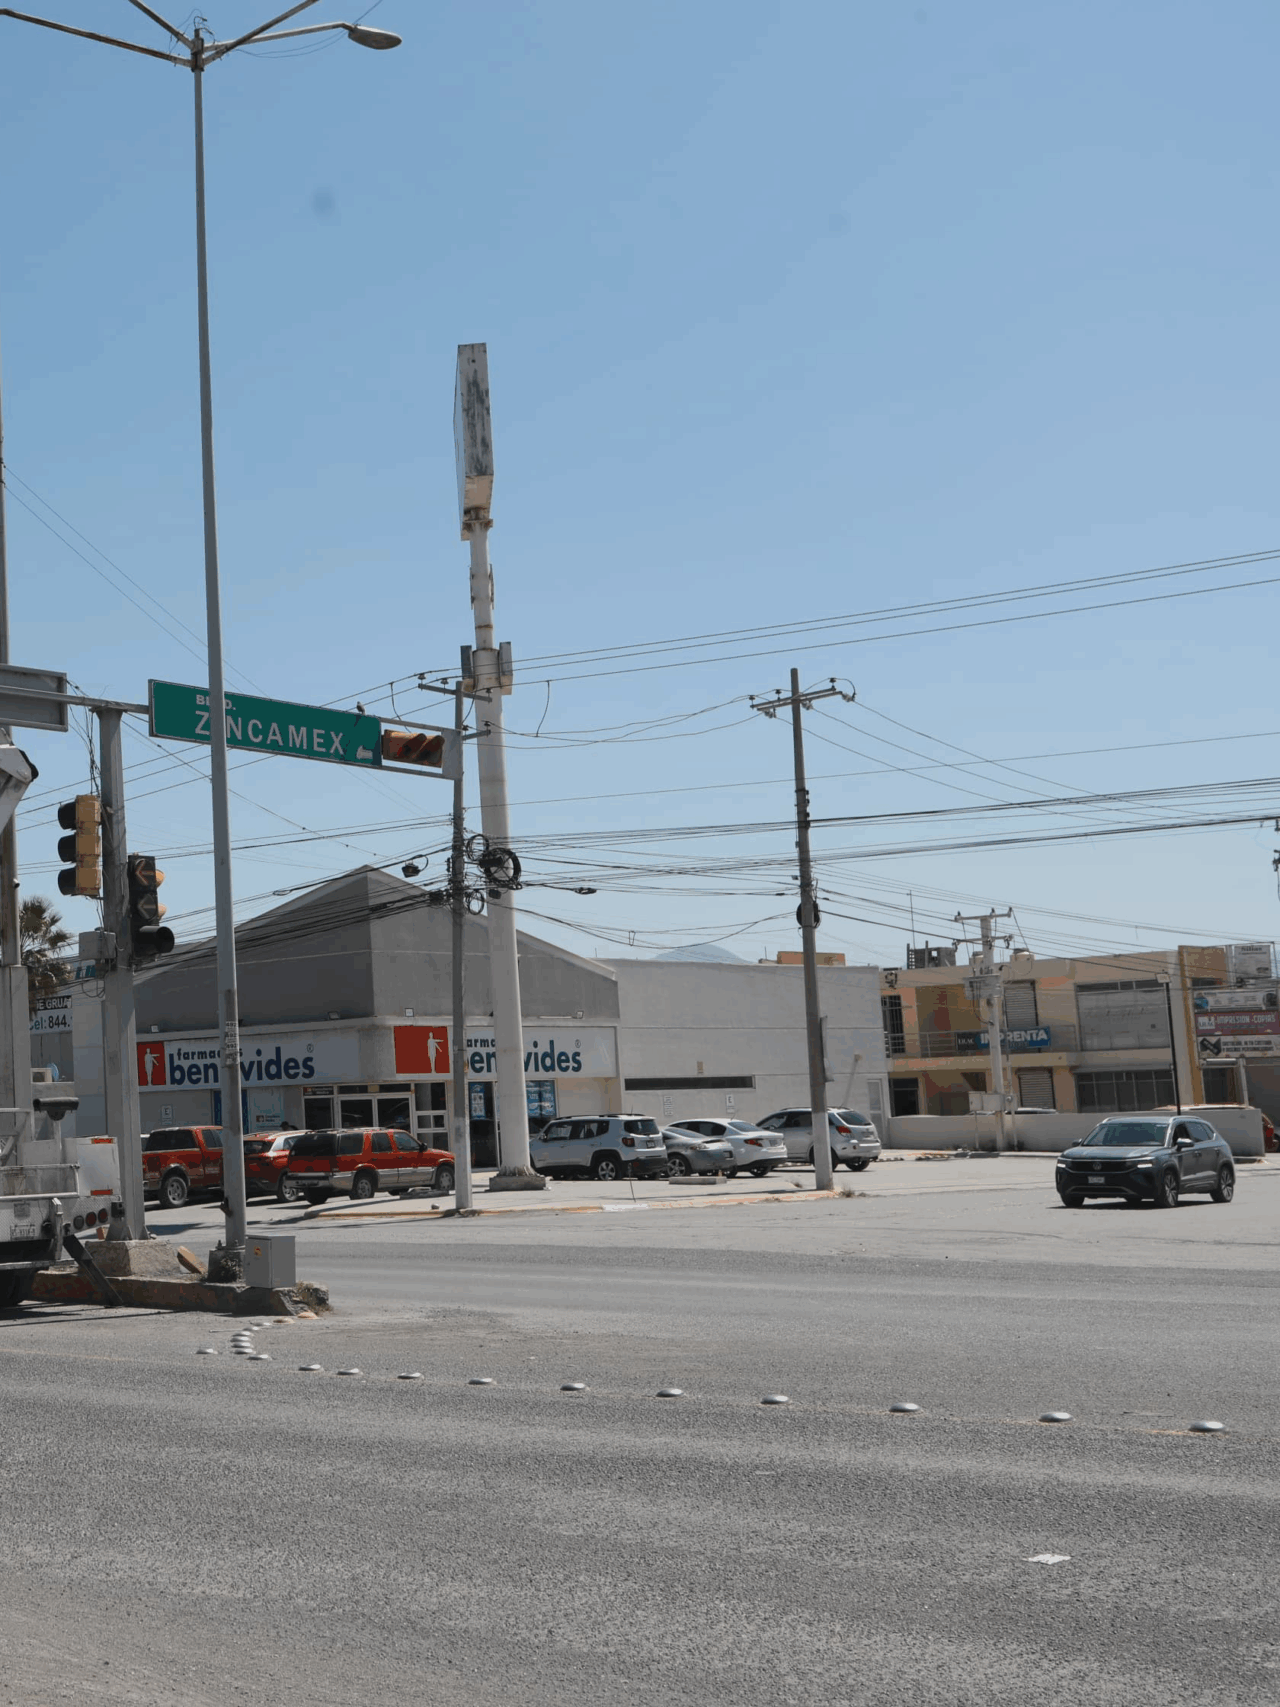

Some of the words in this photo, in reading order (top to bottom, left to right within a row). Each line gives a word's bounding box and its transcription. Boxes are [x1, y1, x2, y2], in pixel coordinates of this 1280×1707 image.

[195, 694, 237, 711] BLD.
[195, 710, 345, 756] ZNCAMEX
[169, 1046, 315, 1085] benvides
[467, 1039, 582, 1073] envides
